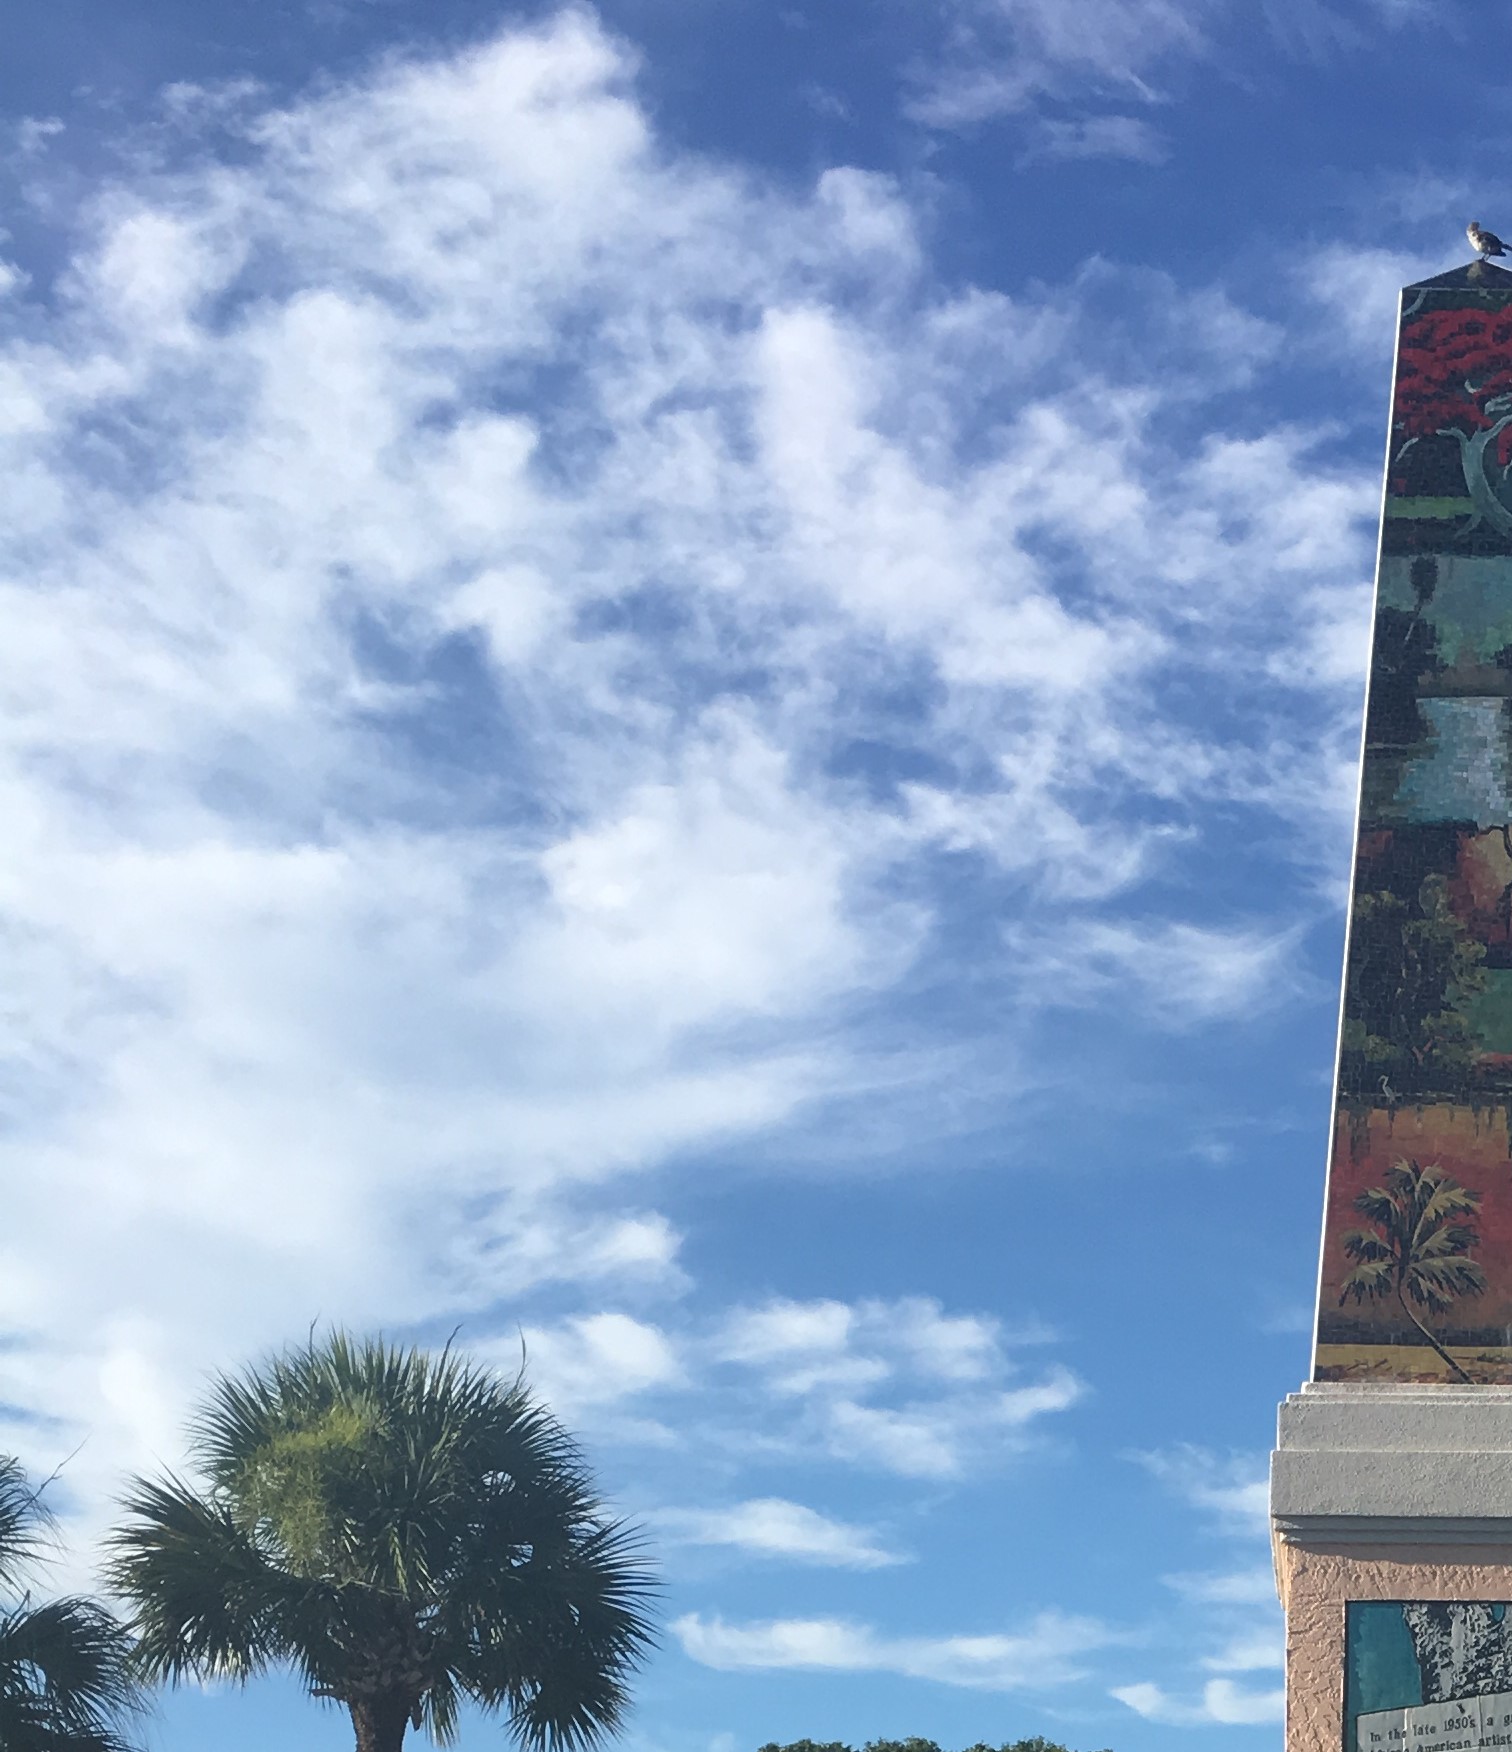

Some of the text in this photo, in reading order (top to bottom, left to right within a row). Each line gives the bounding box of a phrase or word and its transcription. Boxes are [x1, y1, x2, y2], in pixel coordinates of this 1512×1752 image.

[1370, 1732, 1380, 1742] In
[1388, 1726, 1406, 1739] the
[1413, 1724, 1436, 1736] late
[1444, 1716, 1475, 1732] 1950's
[1487, 1717, 1493, 1726] a
